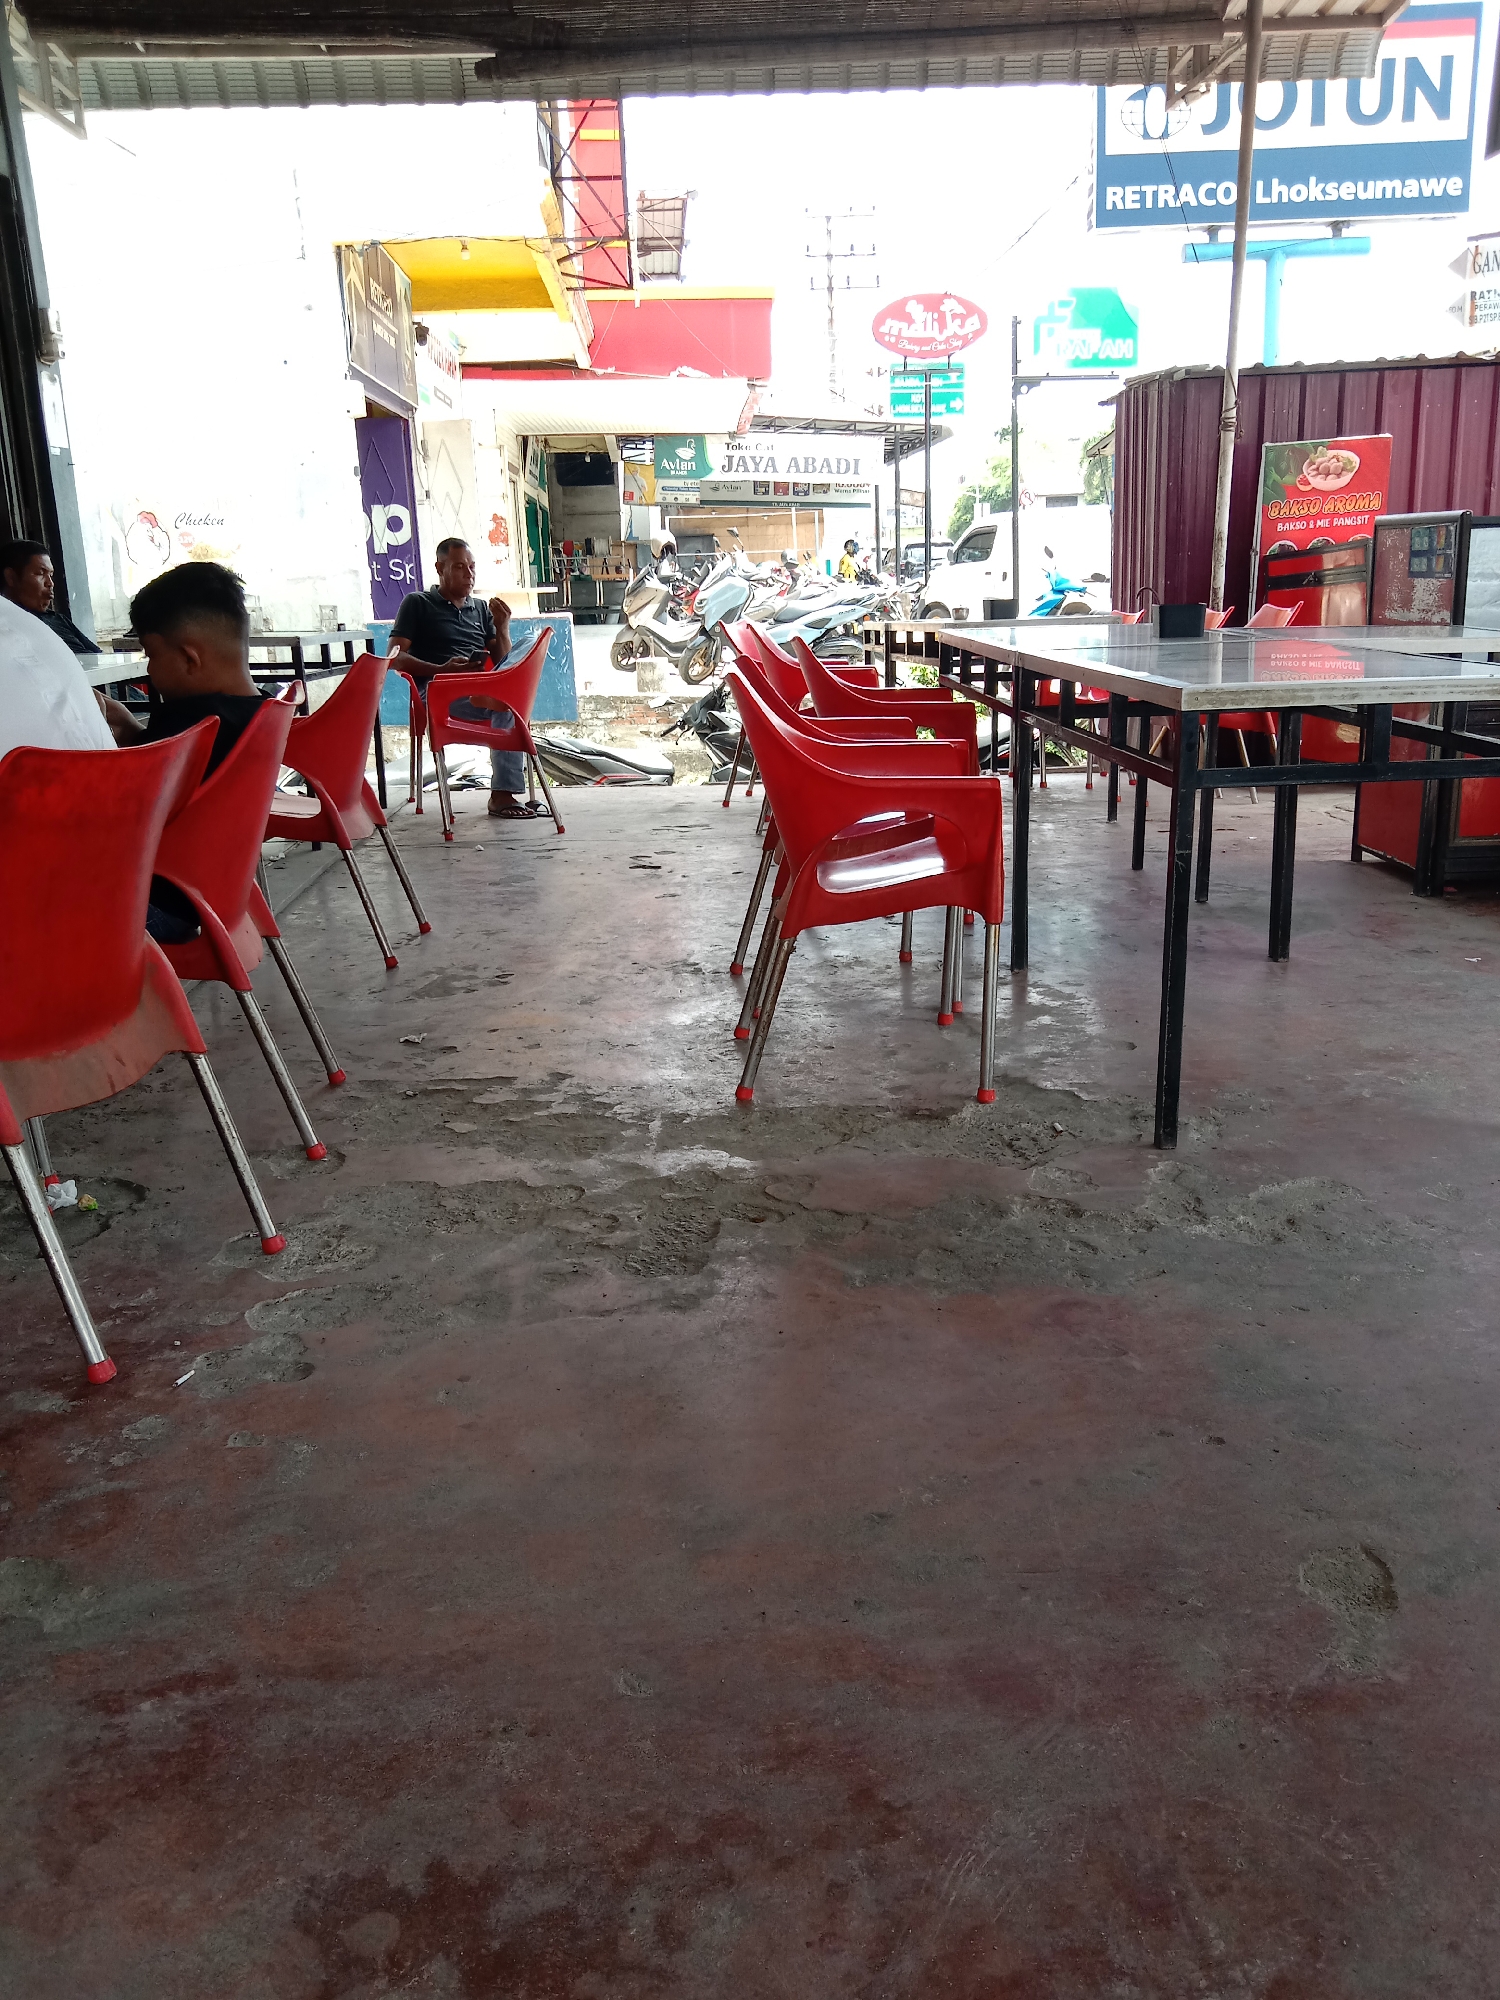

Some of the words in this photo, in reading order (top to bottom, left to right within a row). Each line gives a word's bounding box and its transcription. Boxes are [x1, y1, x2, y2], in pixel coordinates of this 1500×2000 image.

[1105, 181, 1238, 211] RETRACO
[1255, 176, 1464, 205] Lhokseumawe
[660, 458, 697, 471] Avian
[721, 455, 779, 474] JAYA
[786, 456, 861, 476] ABADI
[1269, 497, 1322, 519] BAKSO
[1323, 491, 1382, 514] AROMA
[1277, 520, 1307, 532] BAKSO
[1315, 517, 1332, 528] MIE
[1332, 515, 1371, 527] PANGSIT
